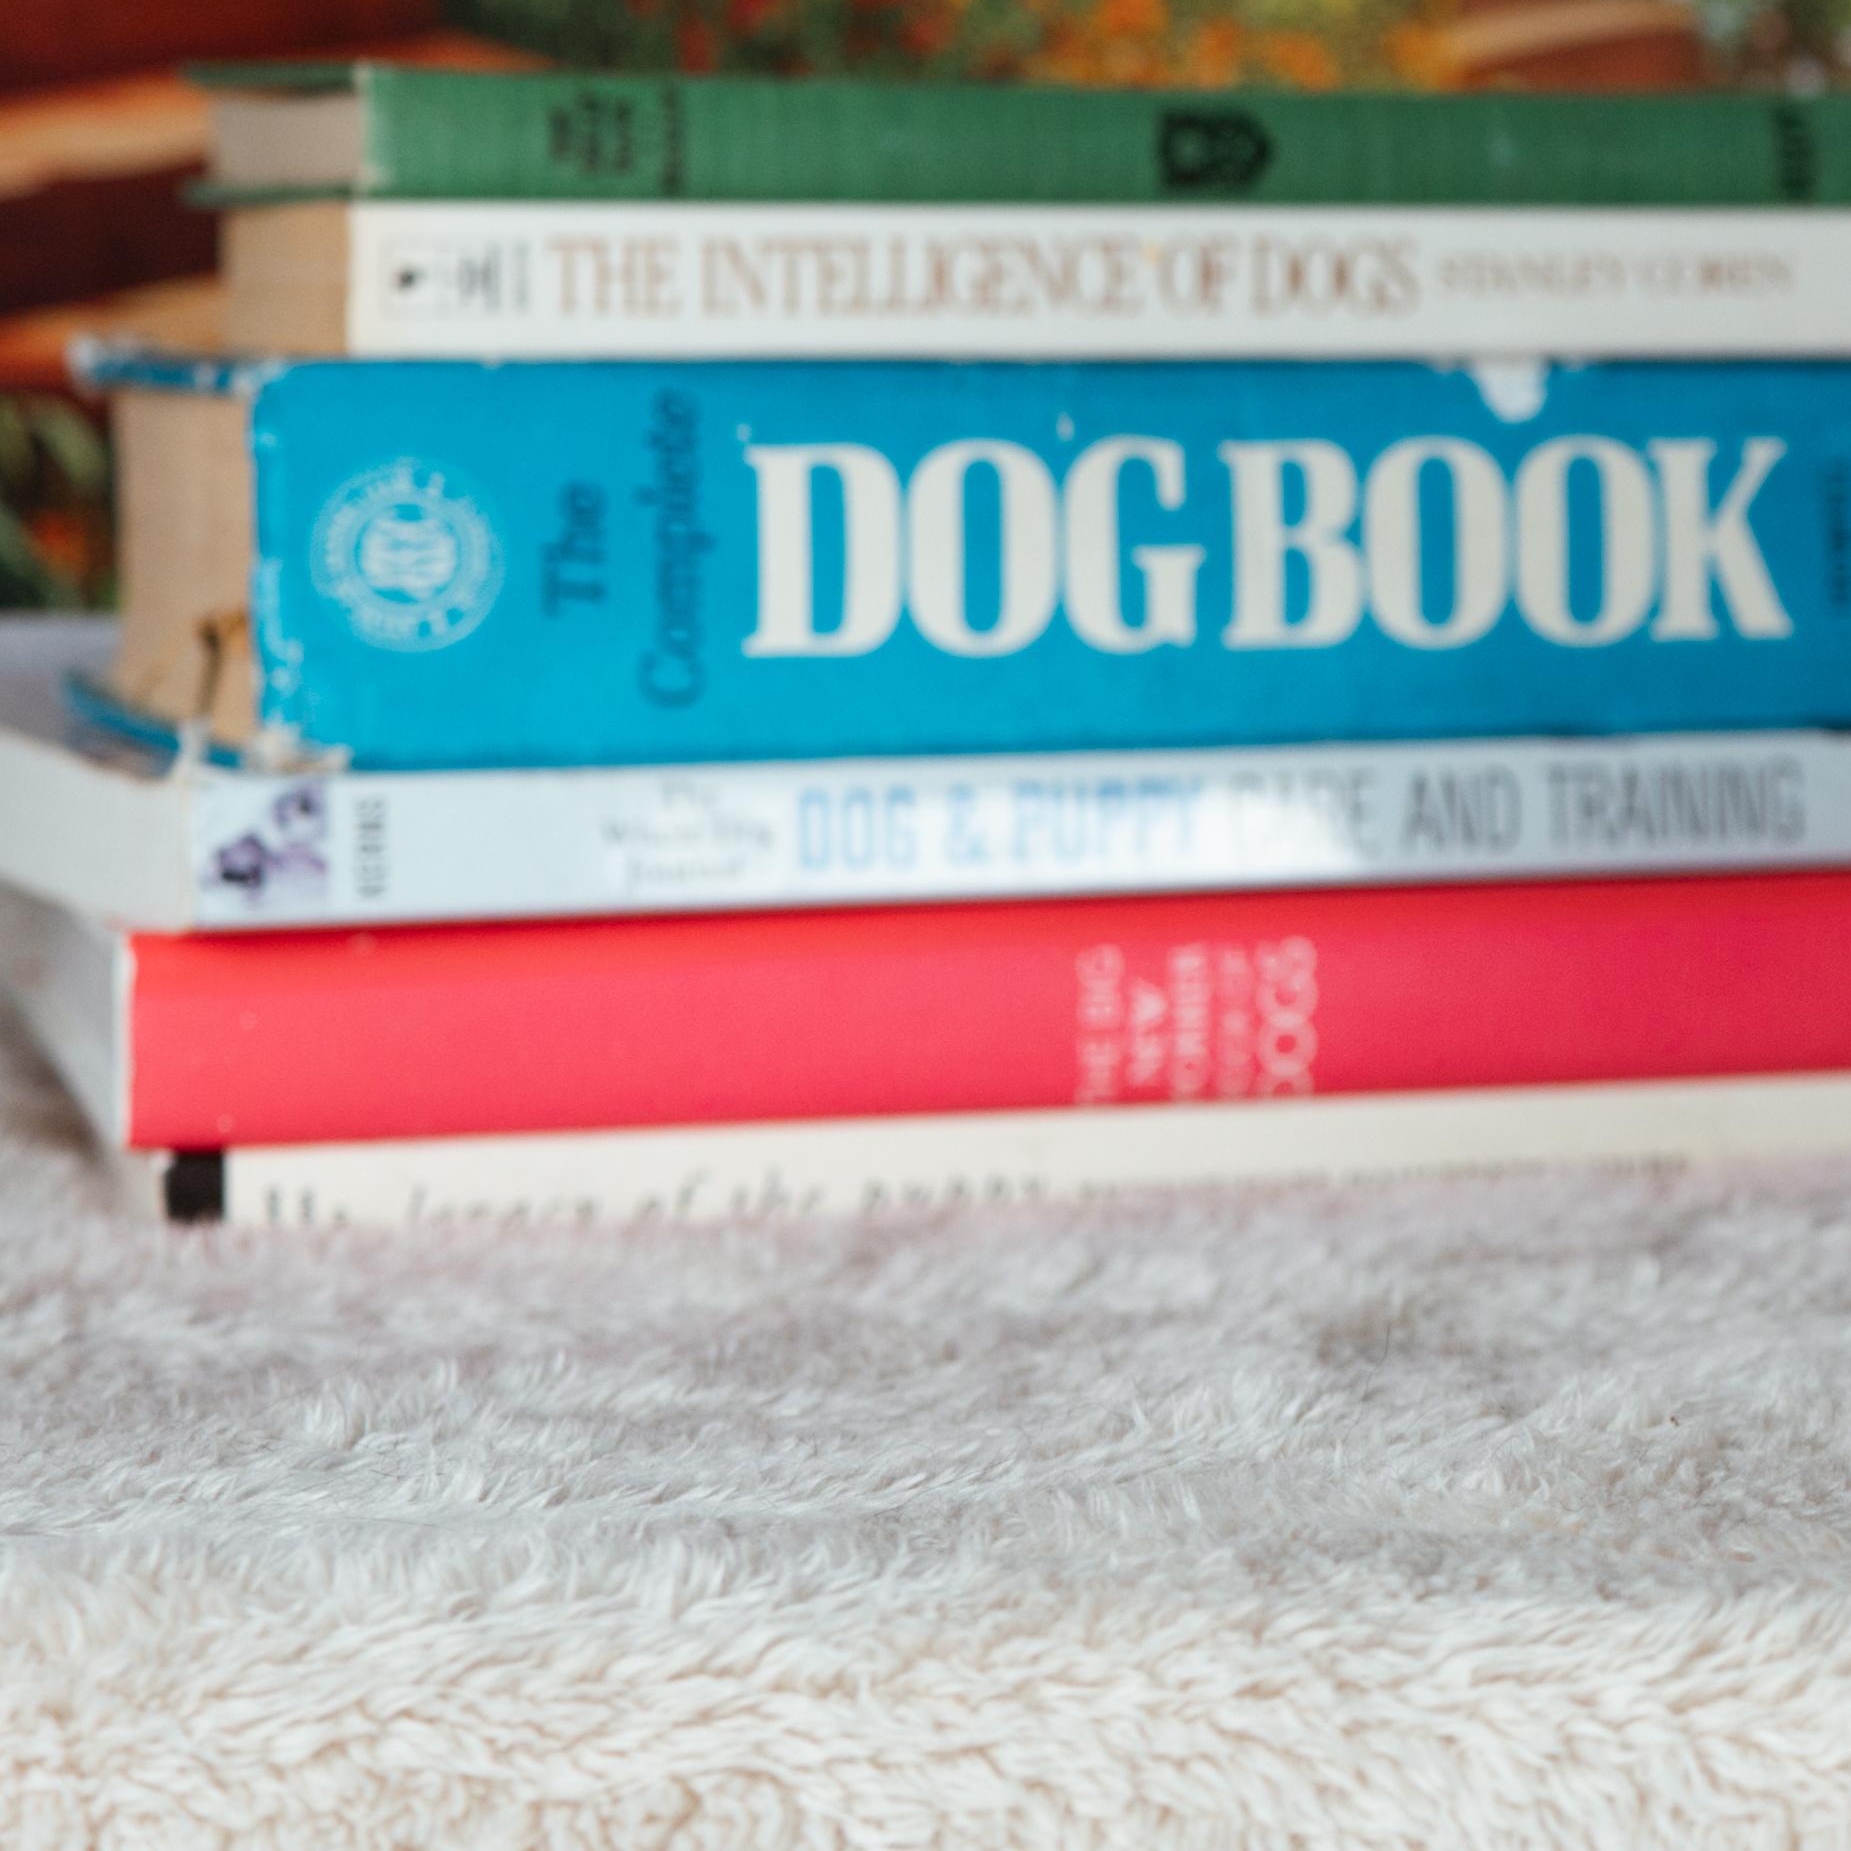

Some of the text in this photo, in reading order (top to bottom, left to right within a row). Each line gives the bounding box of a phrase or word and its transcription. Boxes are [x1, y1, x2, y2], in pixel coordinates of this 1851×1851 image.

[546, 232, 681, 317] THE
[701, 232, 1144, 317] INTELLIGENCE
[1154, 233, 1234, 317] OF
[1249, 232, 1421, 317] DOGS
[540, 479, 608, 619] The
[633, 388, 717, 711] Complete
[741, 433, 1206, 658] DOG
[1218, 433, 1795, 650] BOOK
[798, 783, 917, 871] DOG
[943, 779, 988, 863] &
[1012, 773, 1208, 860] PUPPY
[1403, 760, 1524, 854] AND
[1546, 752, 1807, 848] TRAINING
